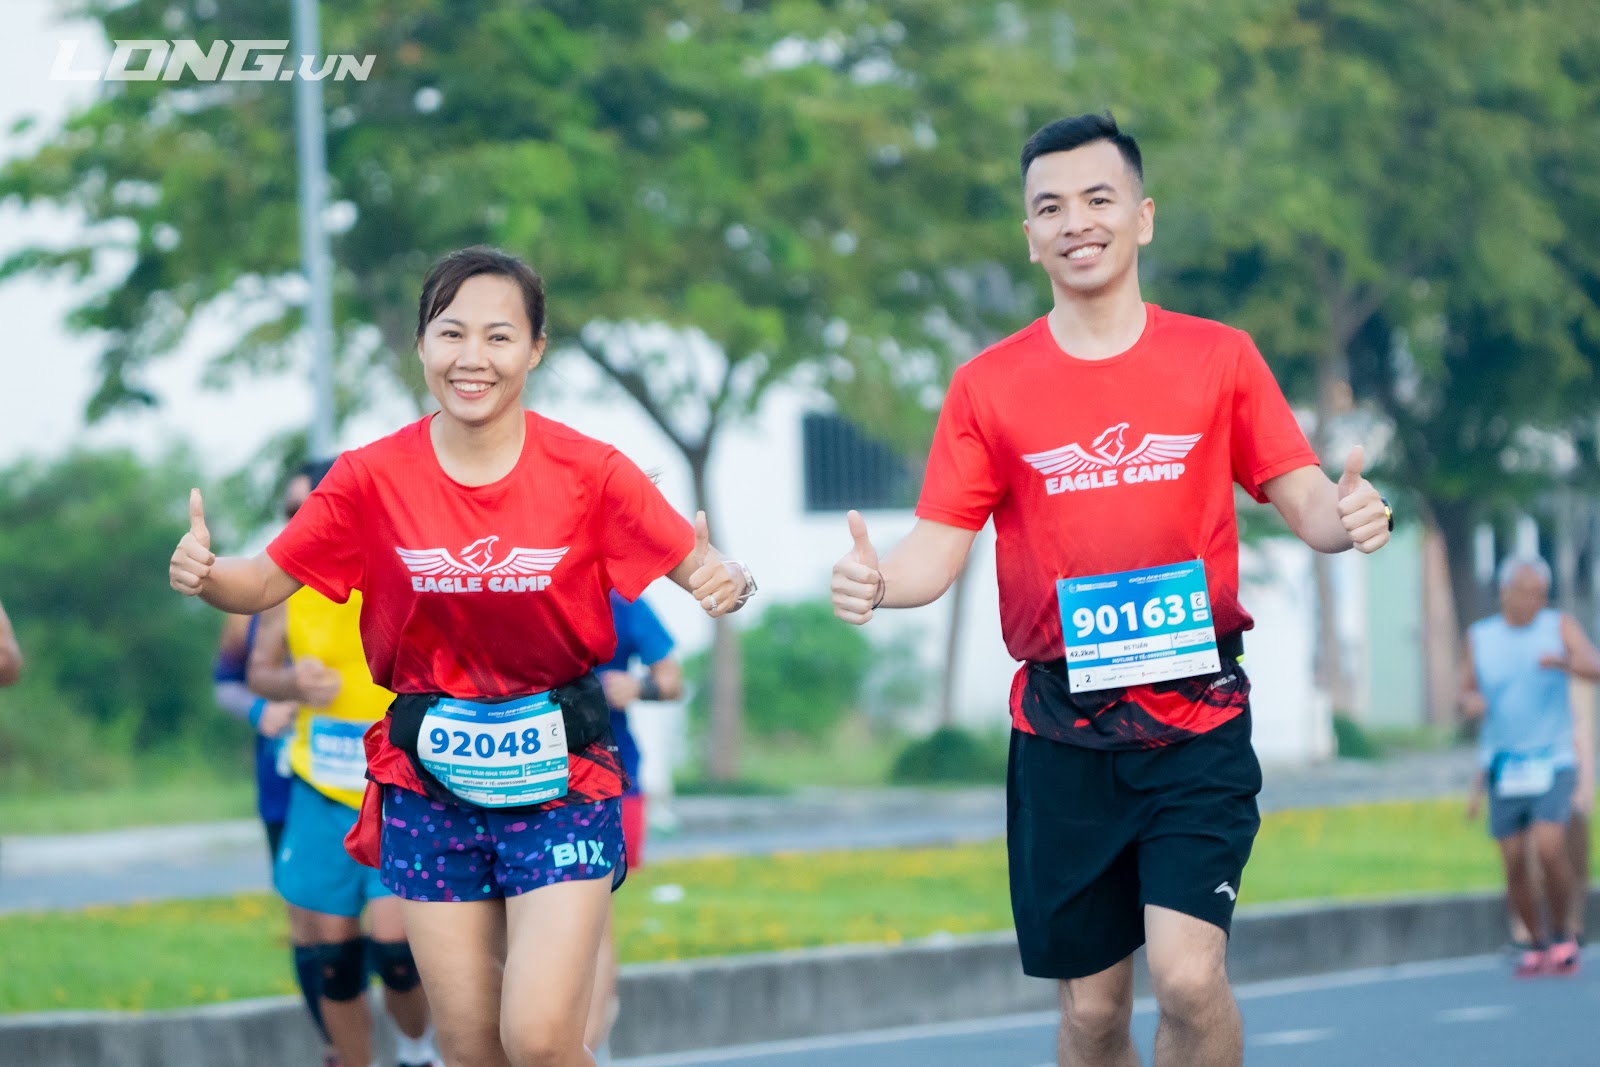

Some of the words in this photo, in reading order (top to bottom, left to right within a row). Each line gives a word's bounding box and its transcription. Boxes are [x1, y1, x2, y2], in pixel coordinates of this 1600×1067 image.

[1045, 469, 1119, 496] EAGLE
[1122, 462, 1186, 485] CAMP
[411, 576, 483, 593] EAGLE
[487, 575, 552, 593] CAMP
[1195, 597, 1203, 606] C
[1072, 594, 1187, 639] 90163
[1084, 674, 1092, 683] 2
[551, 727, 558, 737] C
[429, 727, 541, 759] 92048
